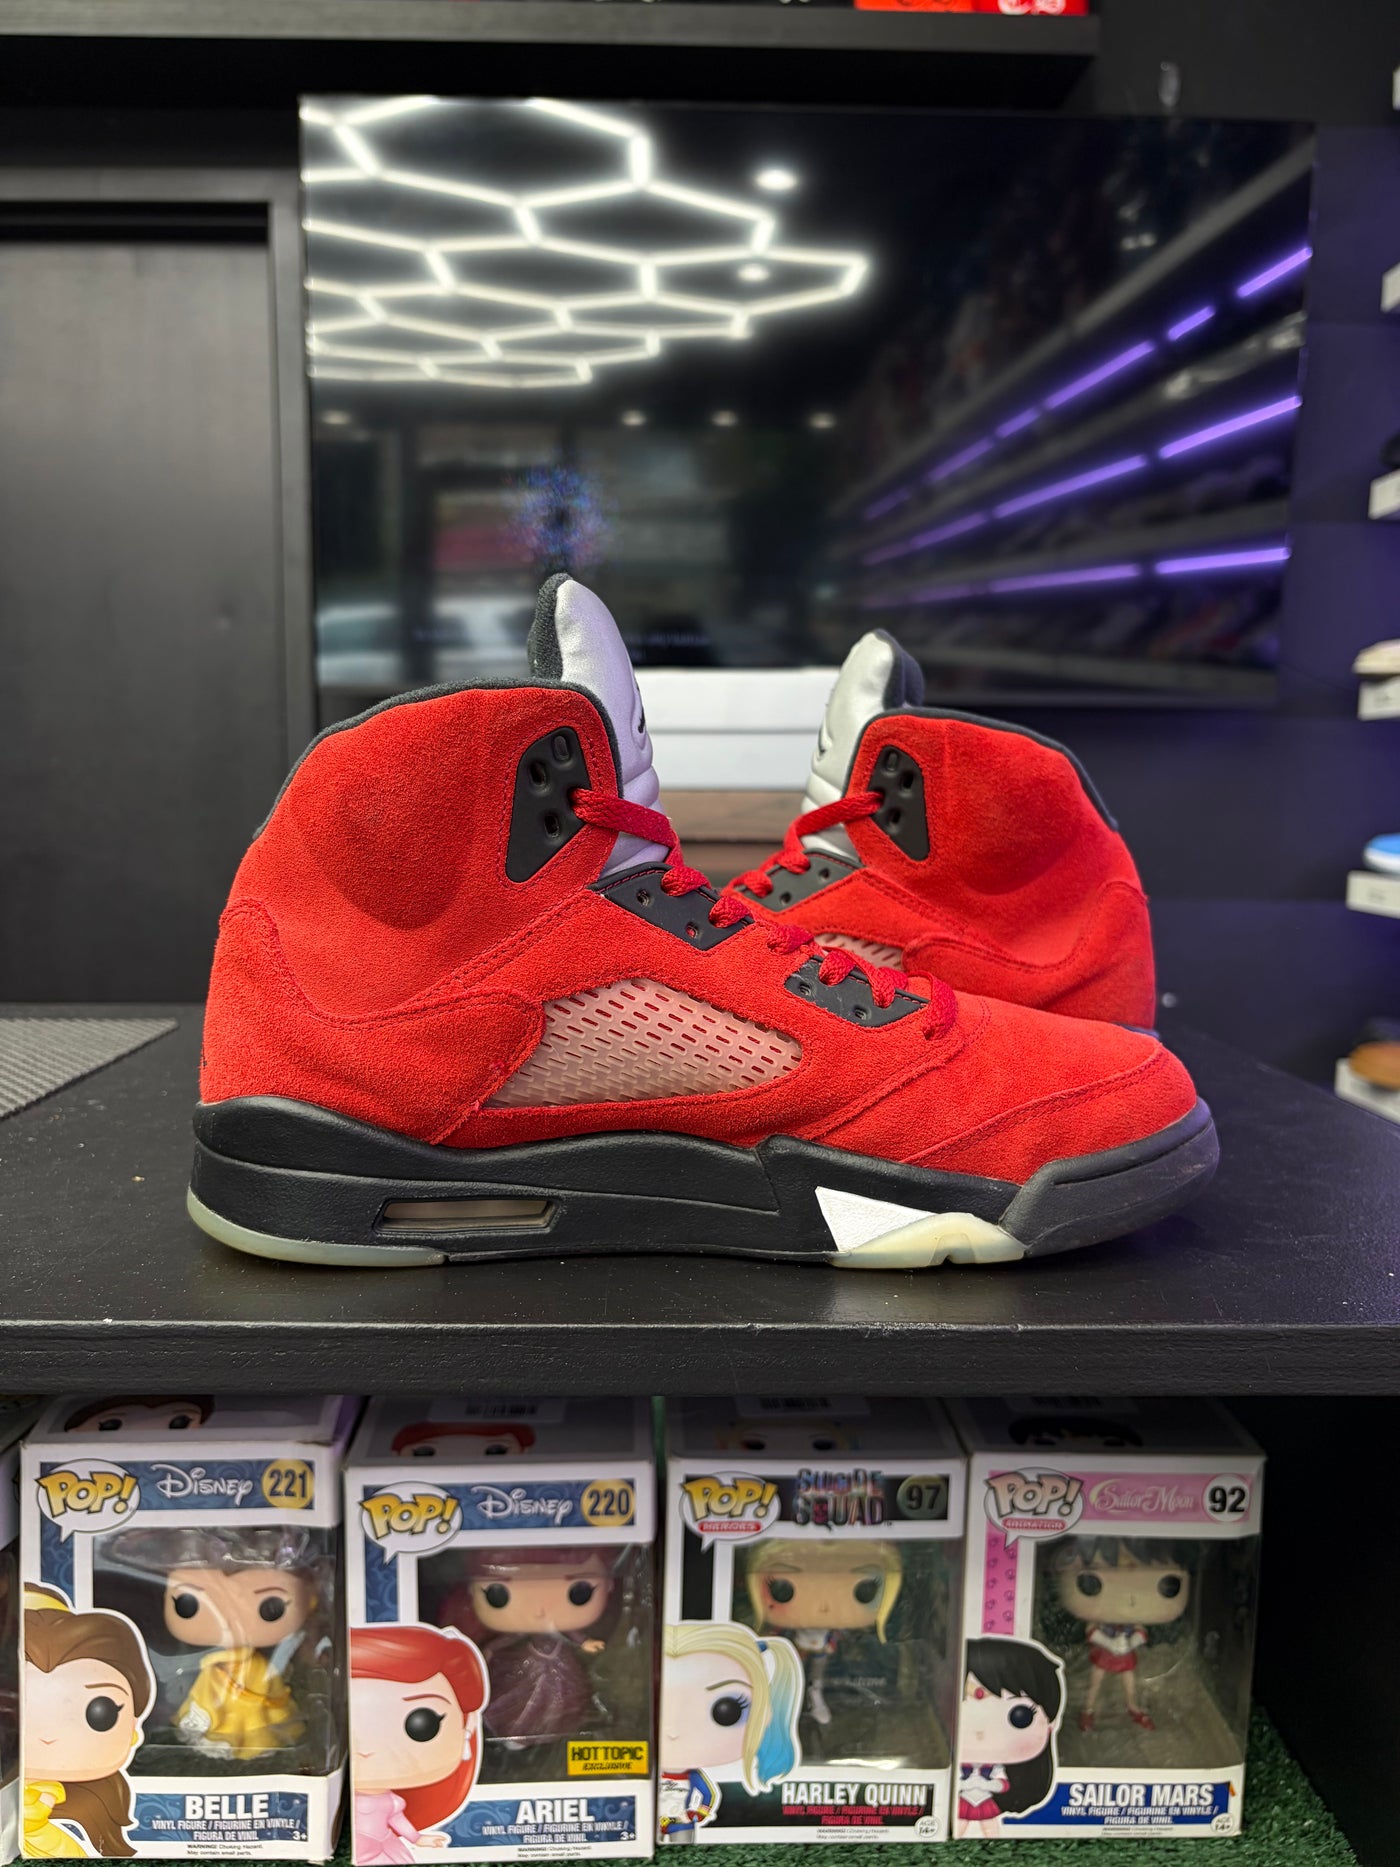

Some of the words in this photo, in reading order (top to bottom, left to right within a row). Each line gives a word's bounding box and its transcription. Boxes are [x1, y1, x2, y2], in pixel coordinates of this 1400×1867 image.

[268, 1469, 307, 1498] 221
[797, 1468, 885, 1492] SUICIDE
[35, 1470, 138, 1518] POP!
[588, 1489, 630, 1516] 220
[680, 1477, 779, 1521] POP!
[906, 1483, 942, 1510] 97
[985, 1471, 1085, 1517] POP!
[1097, 1484, 1145, 1514] Sailor
[1143, 1484, 1194, 1512] Moon
[1208, 1485, 1246, 1513] 92
[359, 1494, 459, 1540] POP!
[794, 1494, 886, 1532] SQUAD
[571, 1746, 599, 1760] HOT
[601, 1746, 644, 1761] TOPIC
[185, 1794, 270, 1820] BELLE
[781, 1782, 860, 1806] HARLEY
[864, 1783, 928, 1807] QUINN
[1069, 1783, 1146, 1806] SAILOR
[1150, 1783, 1214, 1806] MARS
[152, 1819, 176, 1830] VINYL
[177, 1820, 207, 1830] FIGURE
[214, 1819, 252, 1830] FIGURINE
[253, 1819, 266, 1829] EN
[267, 1818, 294, 1829] VINYLE
[516, 1799, 596, 1824] ARIEL
[193, 1830, 223, 1841] FIGURA
[224, 1830, 236, 1841] DE
[292, 1830, 307, 1841] 3+
